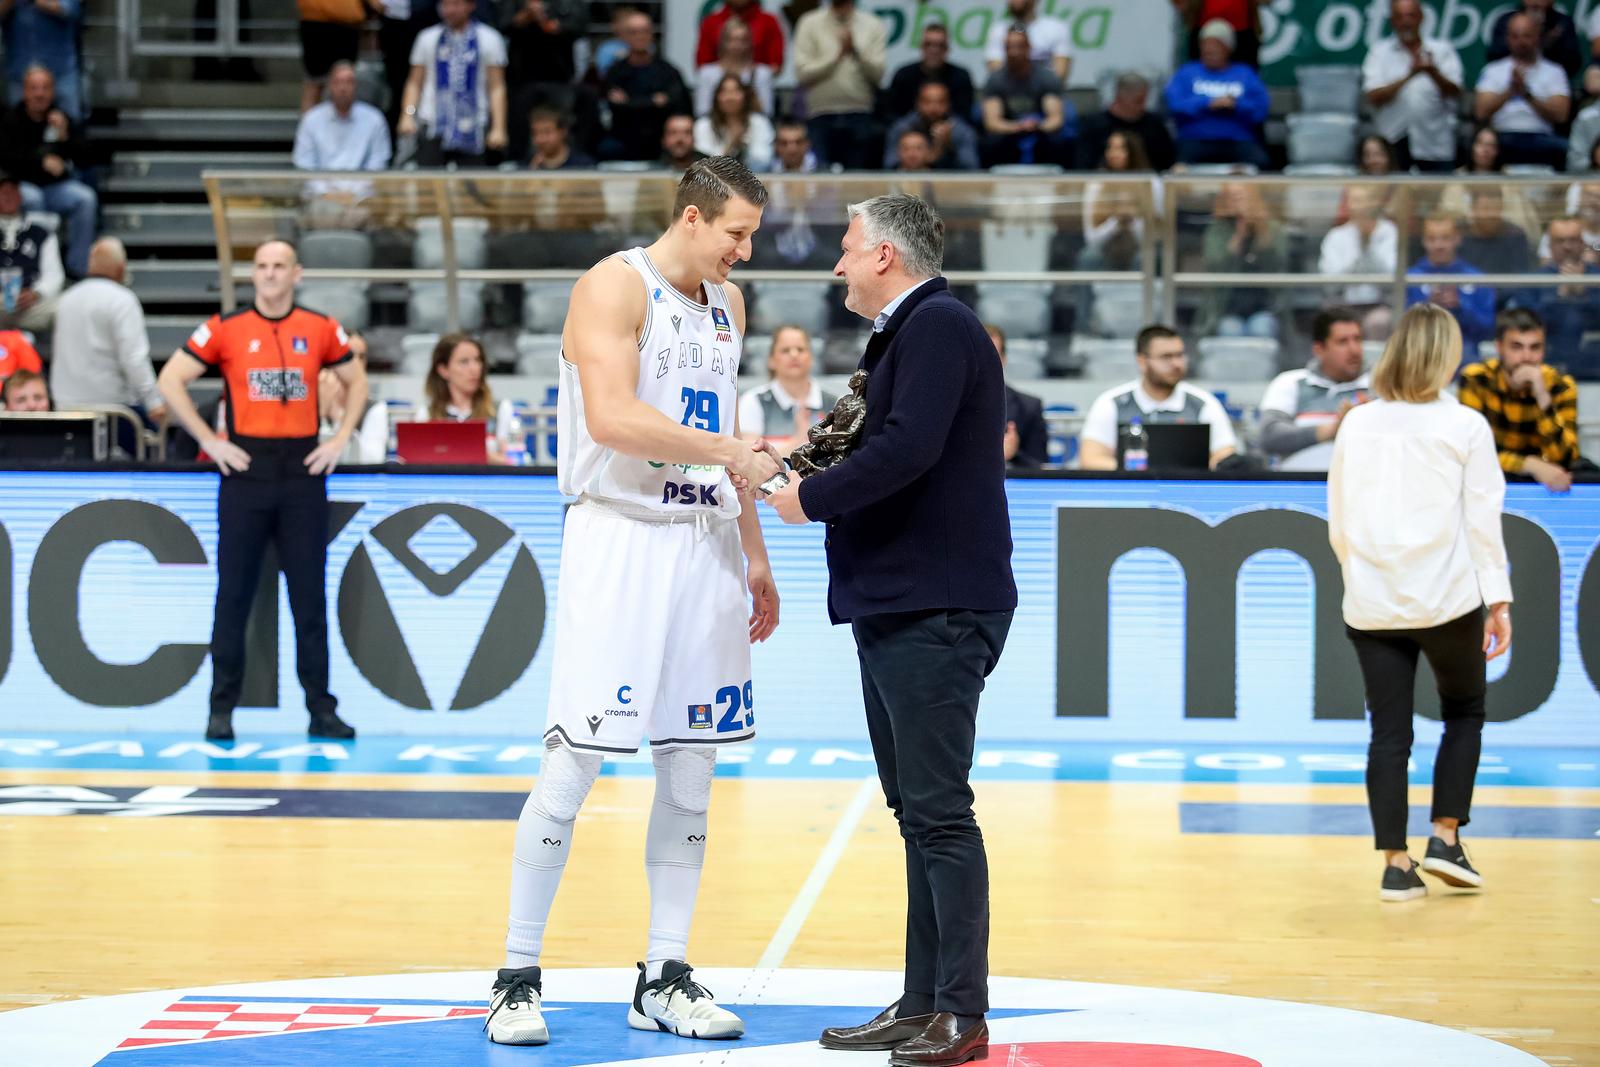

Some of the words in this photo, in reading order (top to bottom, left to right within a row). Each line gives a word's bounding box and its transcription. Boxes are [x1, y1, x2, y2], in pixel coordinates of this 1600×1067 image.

[680, 386, 720, 434] 29
[662, 481, 718, 506] PSK
[604, 709, 639, 717] cromaris
[715, 679, 755, 733] 29
